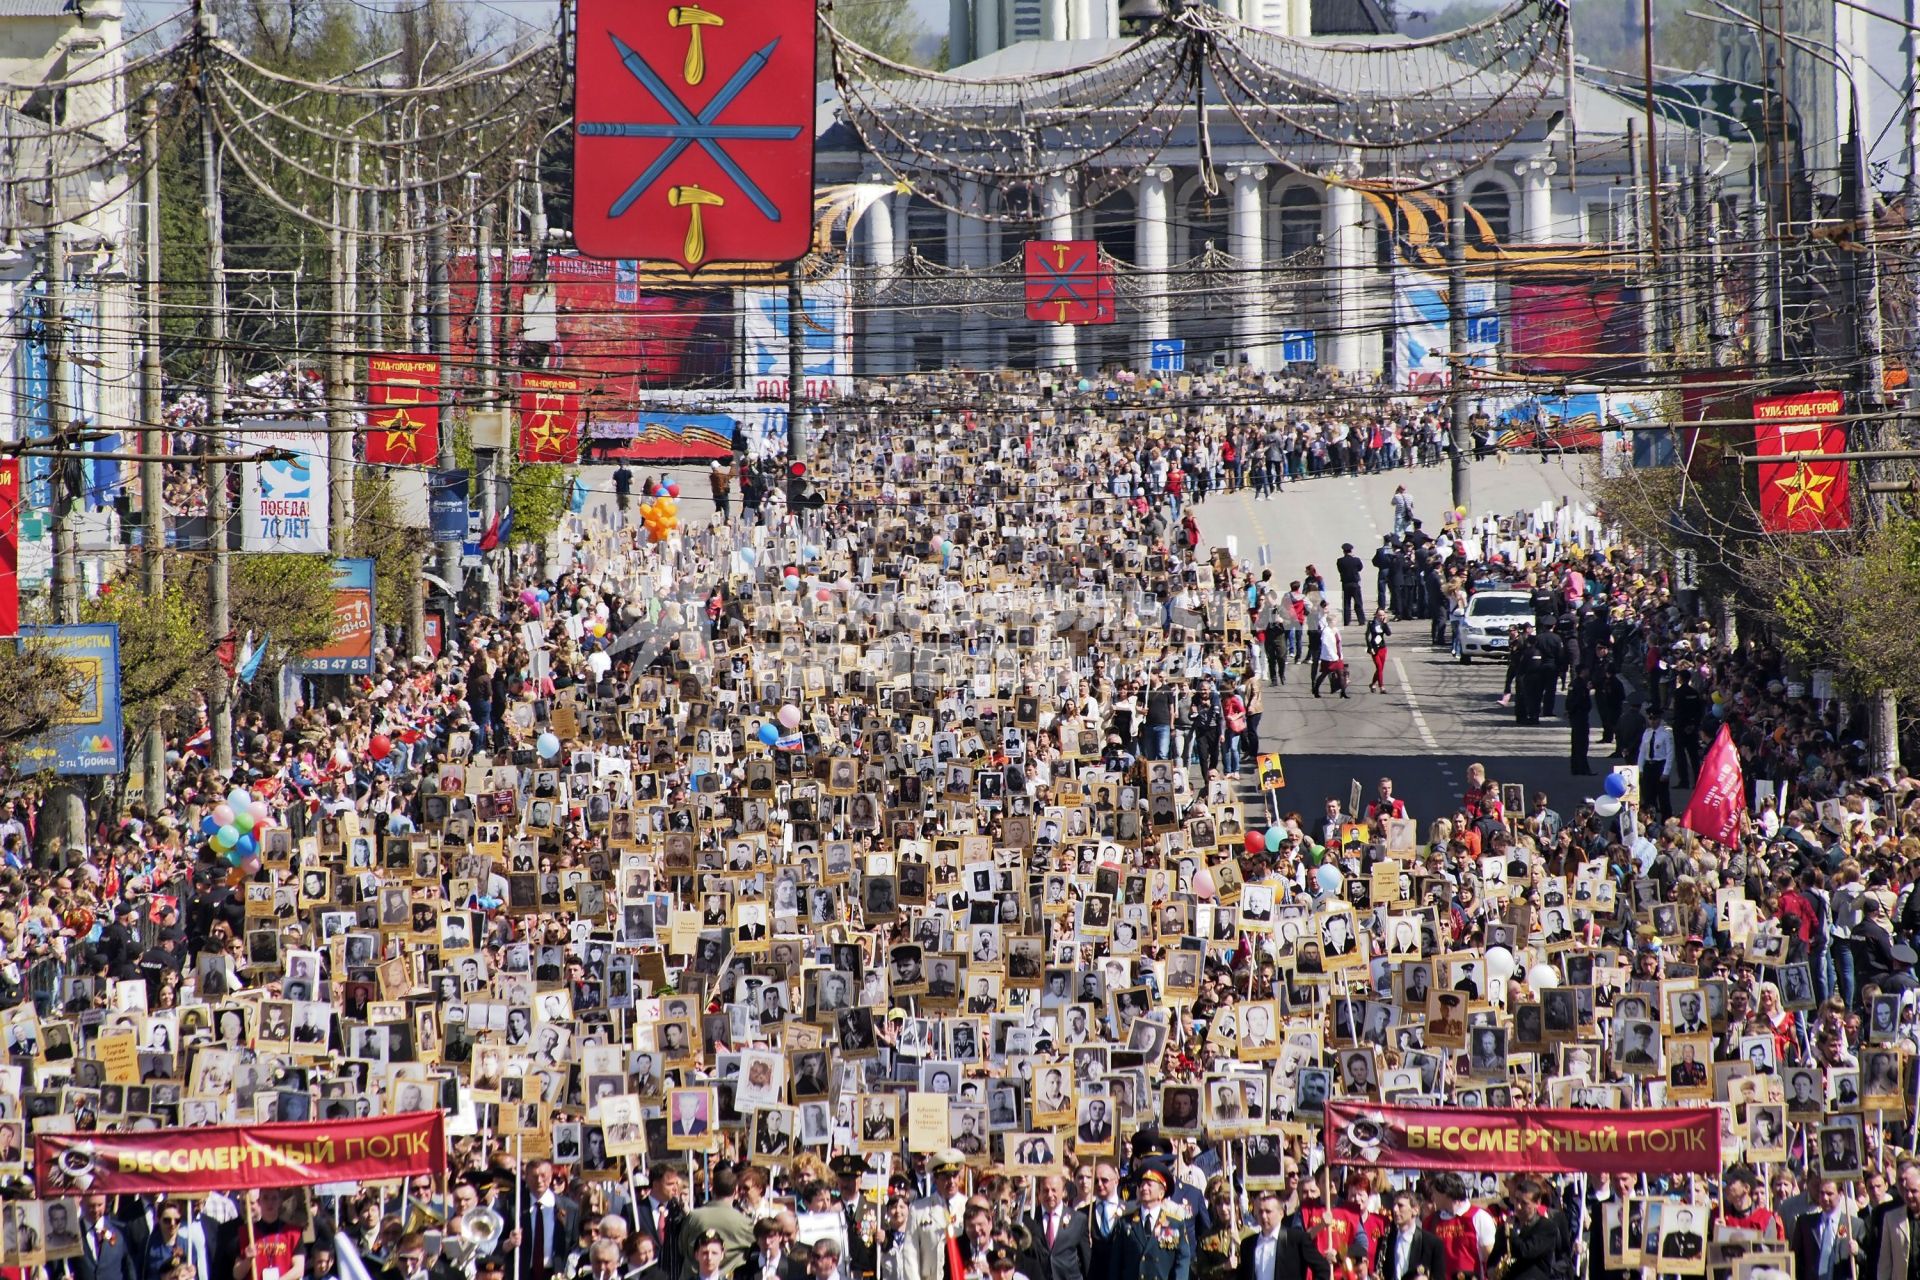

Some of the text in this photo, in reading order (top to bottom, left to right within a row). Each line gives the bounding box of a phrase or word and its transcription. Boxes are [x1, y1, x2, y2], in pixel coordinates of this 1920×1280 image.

[1760, 400, 1839, 417] ТУЛА-ГОРОД-ГЕРОЙ
[260, 500, 310, 517] ПОБЕДА!
[261, 518, 310, 539] 70 ЛЕТ
[331, 659, 347, 670] 47
[78, 756, 116, 768] Тройка
[1407, 1125, 1706, 1154] БЕССМЕРТНЫЙ ПОЛК
[118, 1130, 431, 1174] БЕССМЕРТНЫЙ ПОЛК
